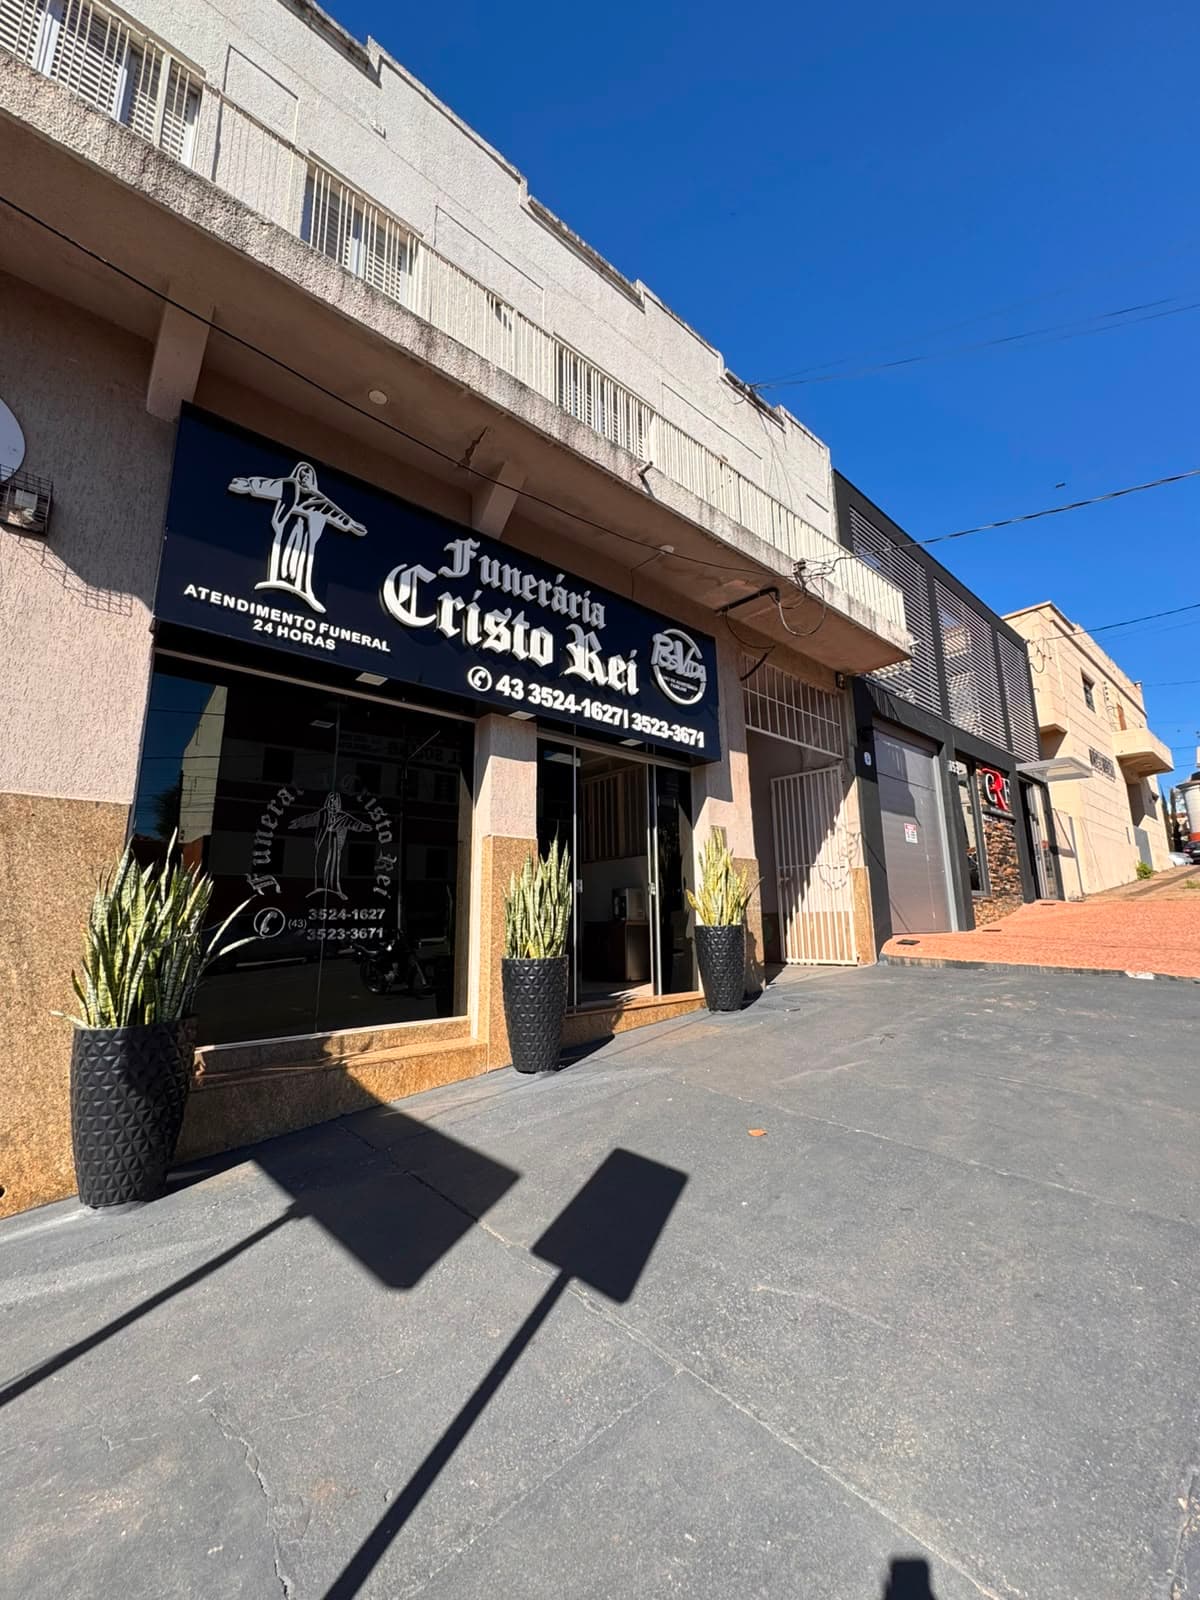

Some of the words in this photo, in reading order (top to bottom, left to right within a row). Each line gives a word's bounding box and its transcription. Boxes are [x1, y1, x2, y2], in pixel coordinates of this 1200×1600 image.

[438, 537, 607, 629] Funerária
[184, 584, 316, 631] ATENDIMENTO
[319, 622, 391, 652] FUNERAL
[252, 618, 274, 634] 24
[277, 626, 336, 650] HORAS
[382, 563, 554, 667] Cristo
[562, 624, 640, 696] Rei
[496, 674, 524, 700] 43
[632, 711, 704, 748] 3523-3671
[287, 915, 308, 929] (43)
[306, 927, 384, 940] 3523-3671
[308, 908, 386, 921] 3524-1627
